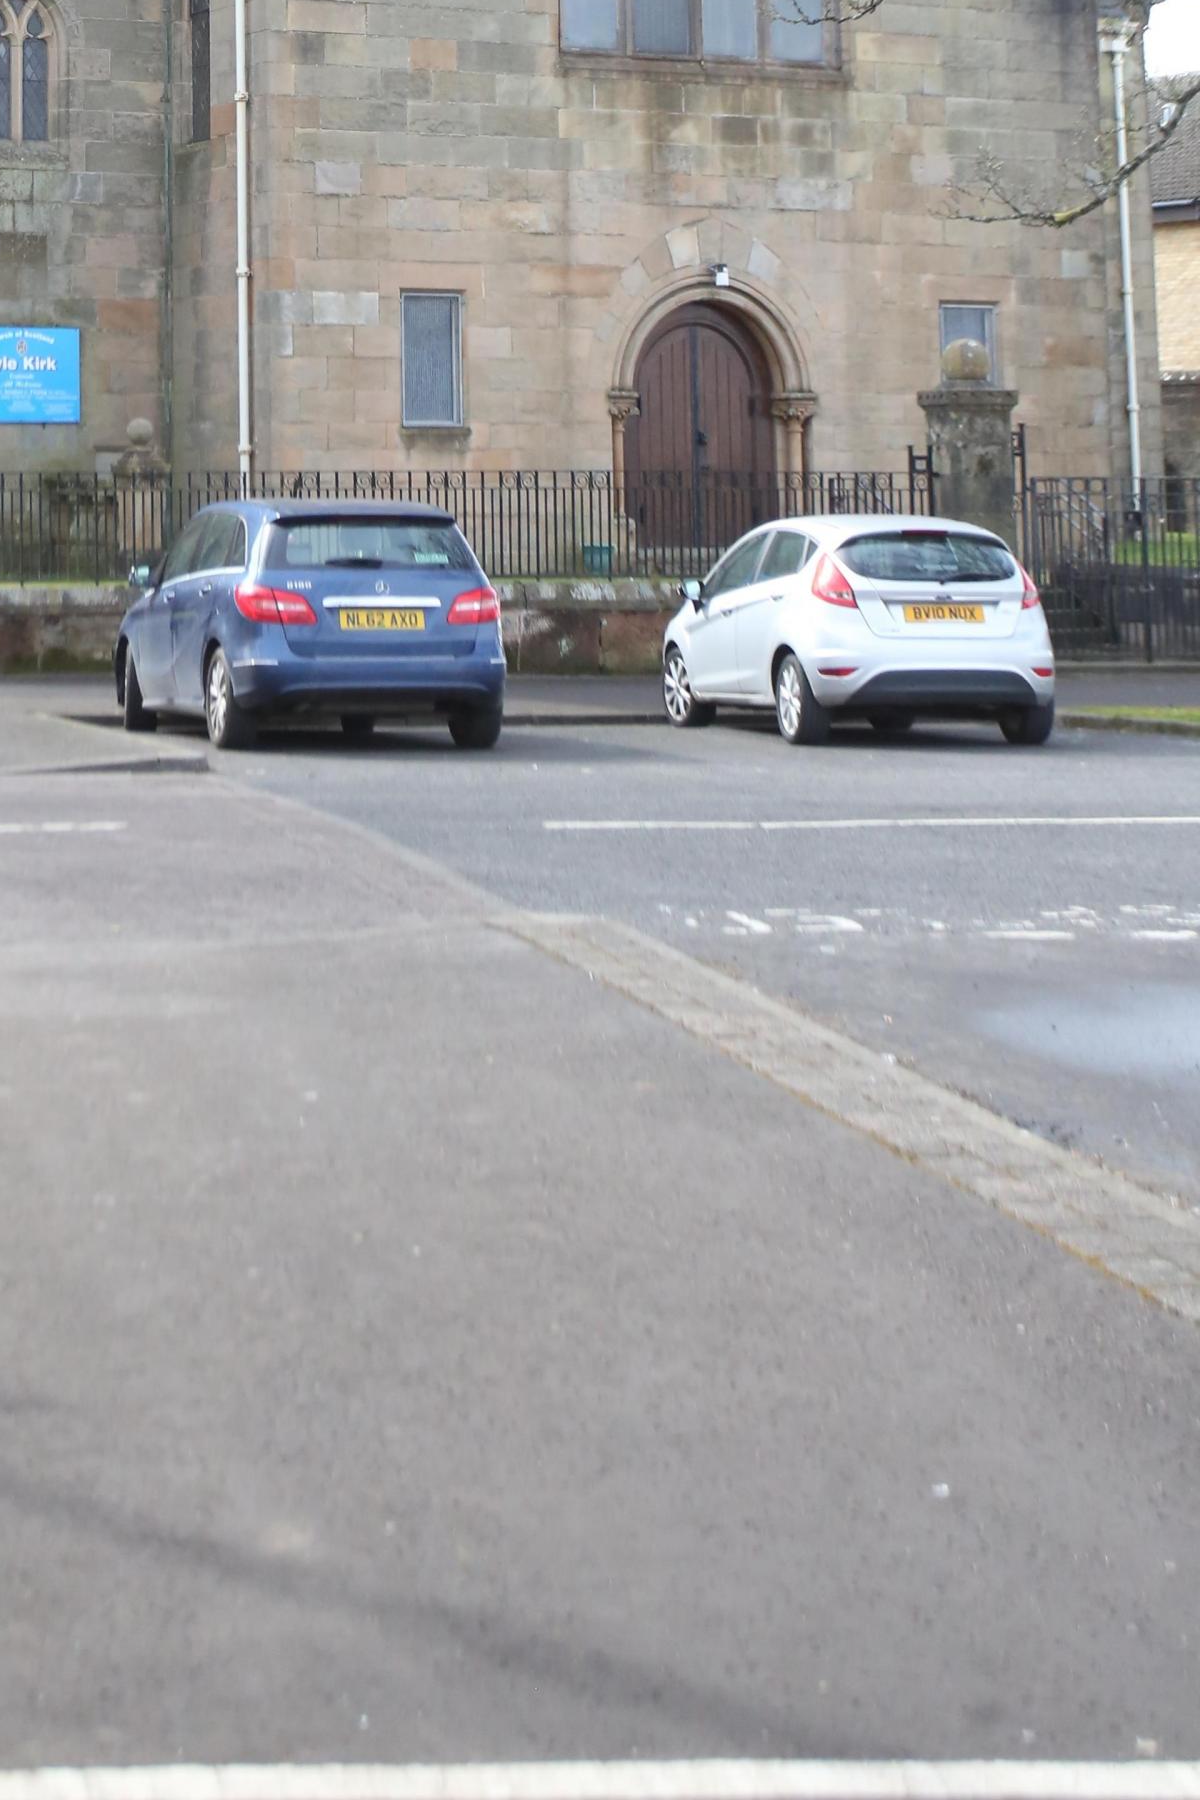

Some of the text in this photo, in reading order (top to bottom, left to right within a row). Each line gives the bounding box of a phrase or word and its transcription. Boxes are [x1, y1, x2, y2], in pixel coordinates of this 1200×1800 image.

[23, 355, 57, 371] Kirk
[346, 611, 385, 628] NL62
[948, 606, 977, 620] NUX
